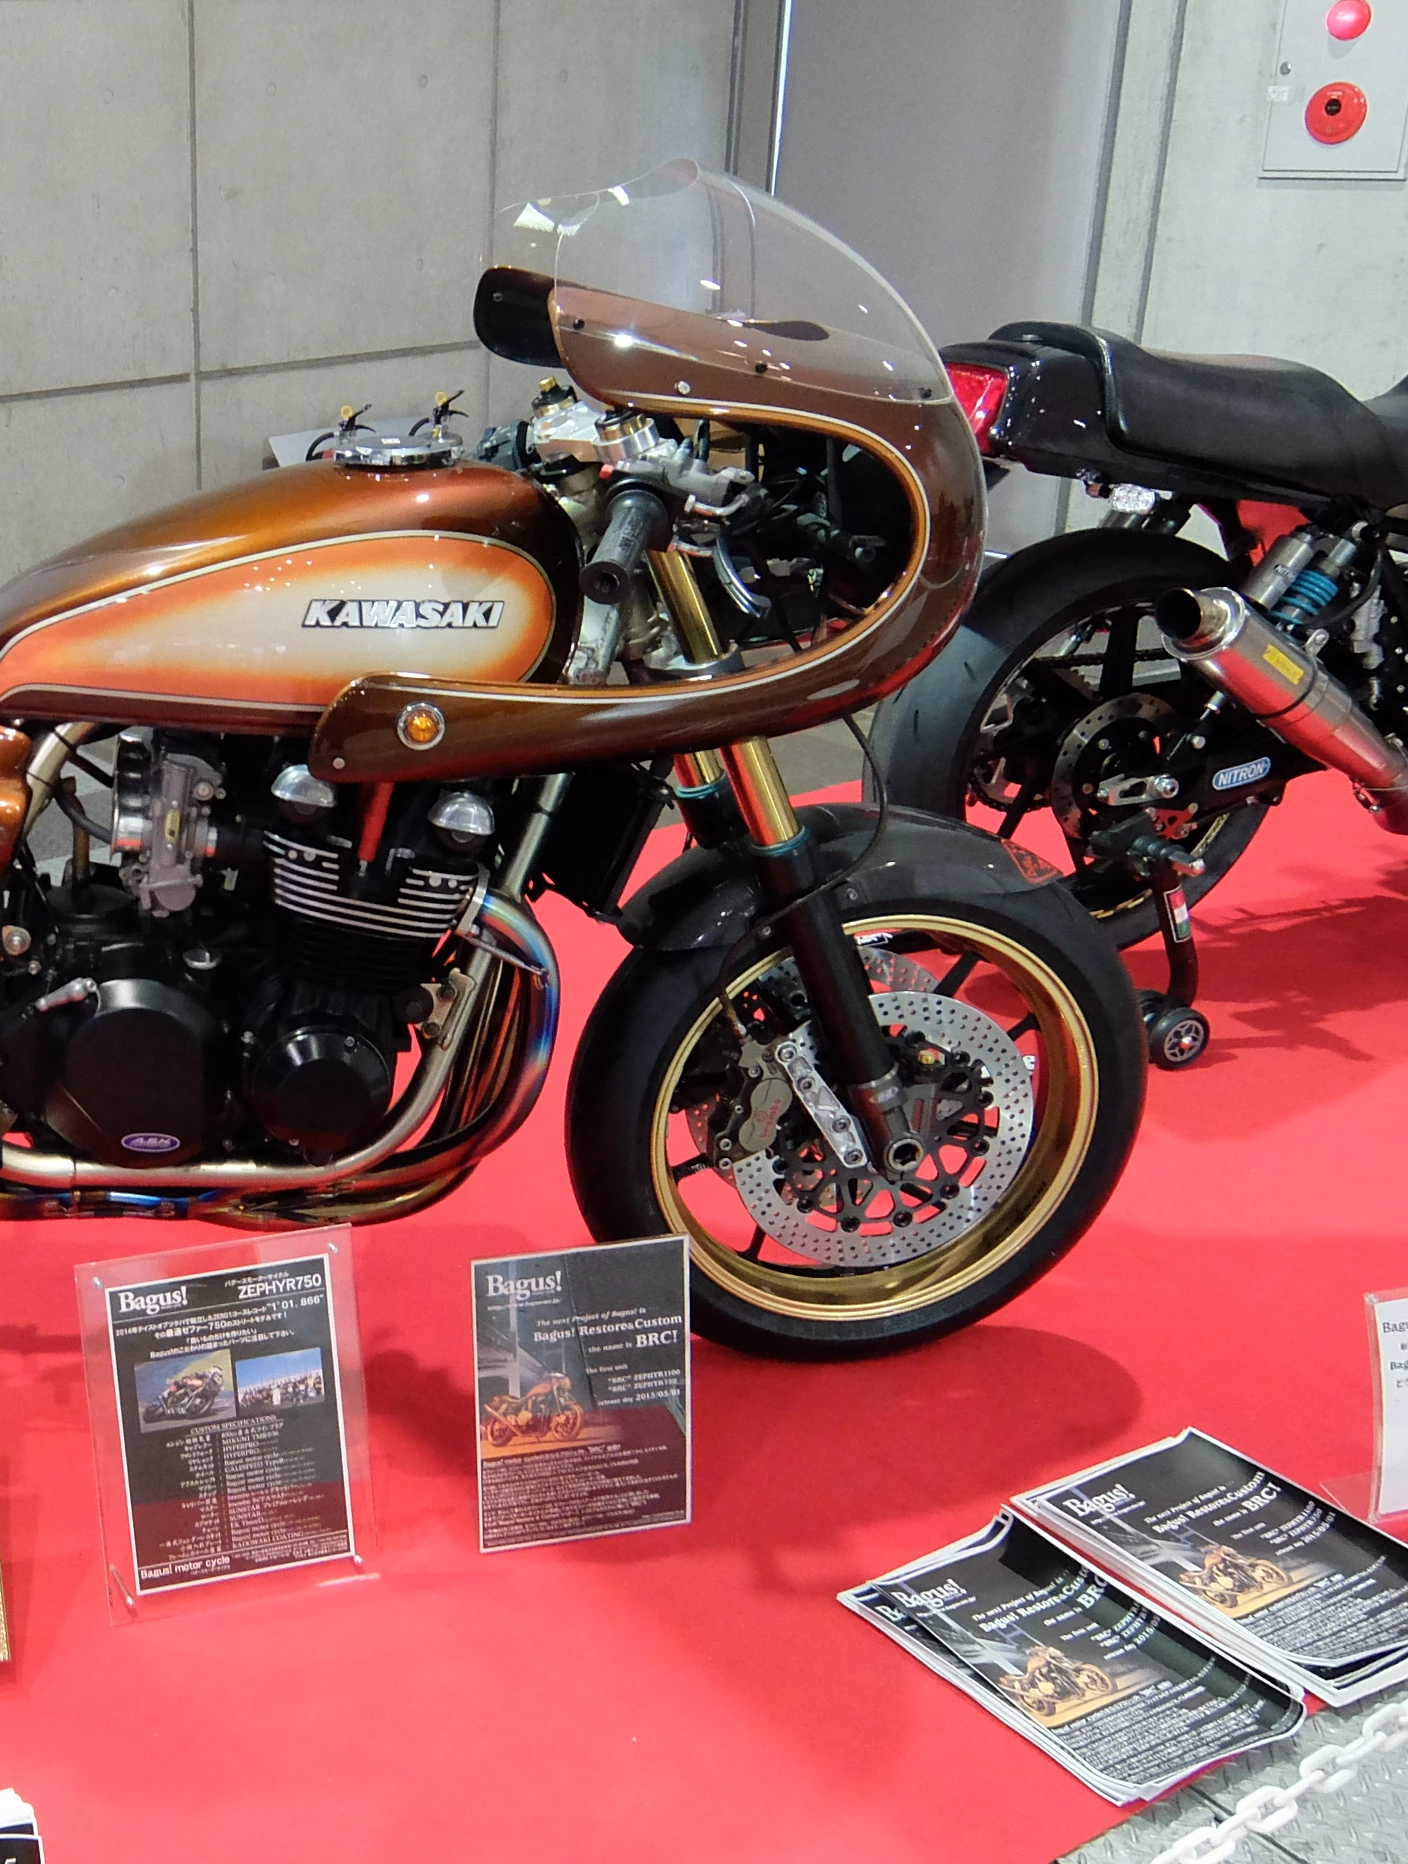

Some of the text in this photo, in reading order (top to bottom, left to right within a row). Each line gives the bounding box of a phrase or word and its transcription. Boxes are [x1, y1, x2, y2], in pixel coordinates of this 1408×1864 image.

[302, 599, 505, 629] KAWASAKI
[1218, 761, 1265, 787] NITRON
[238, 1273, 322, 1300] ZEPHYR750
[486, 1271, 562, 1300] Bagus!
[118, 1285, 189, 1315] Bagus!
[534, 1315, 682, 1342] Bagus! Restore&Custom
[603, 1344, 624, 1352] name
[636, 1330, 678, 1348] BRC!
[1062, 1484, 1137, 1518] Bagus!
[1241, 1482, 1281, 1513] BRC!
[1152, 1513, 1190, 1534] Bagus!
[175, 1561, 202, 1573] motor
[205, 1555, 230, 1568] cycle
[891, 1578, 968, 1611] Bagus!
[978, 1611, 1020, 1633] Bagus!
